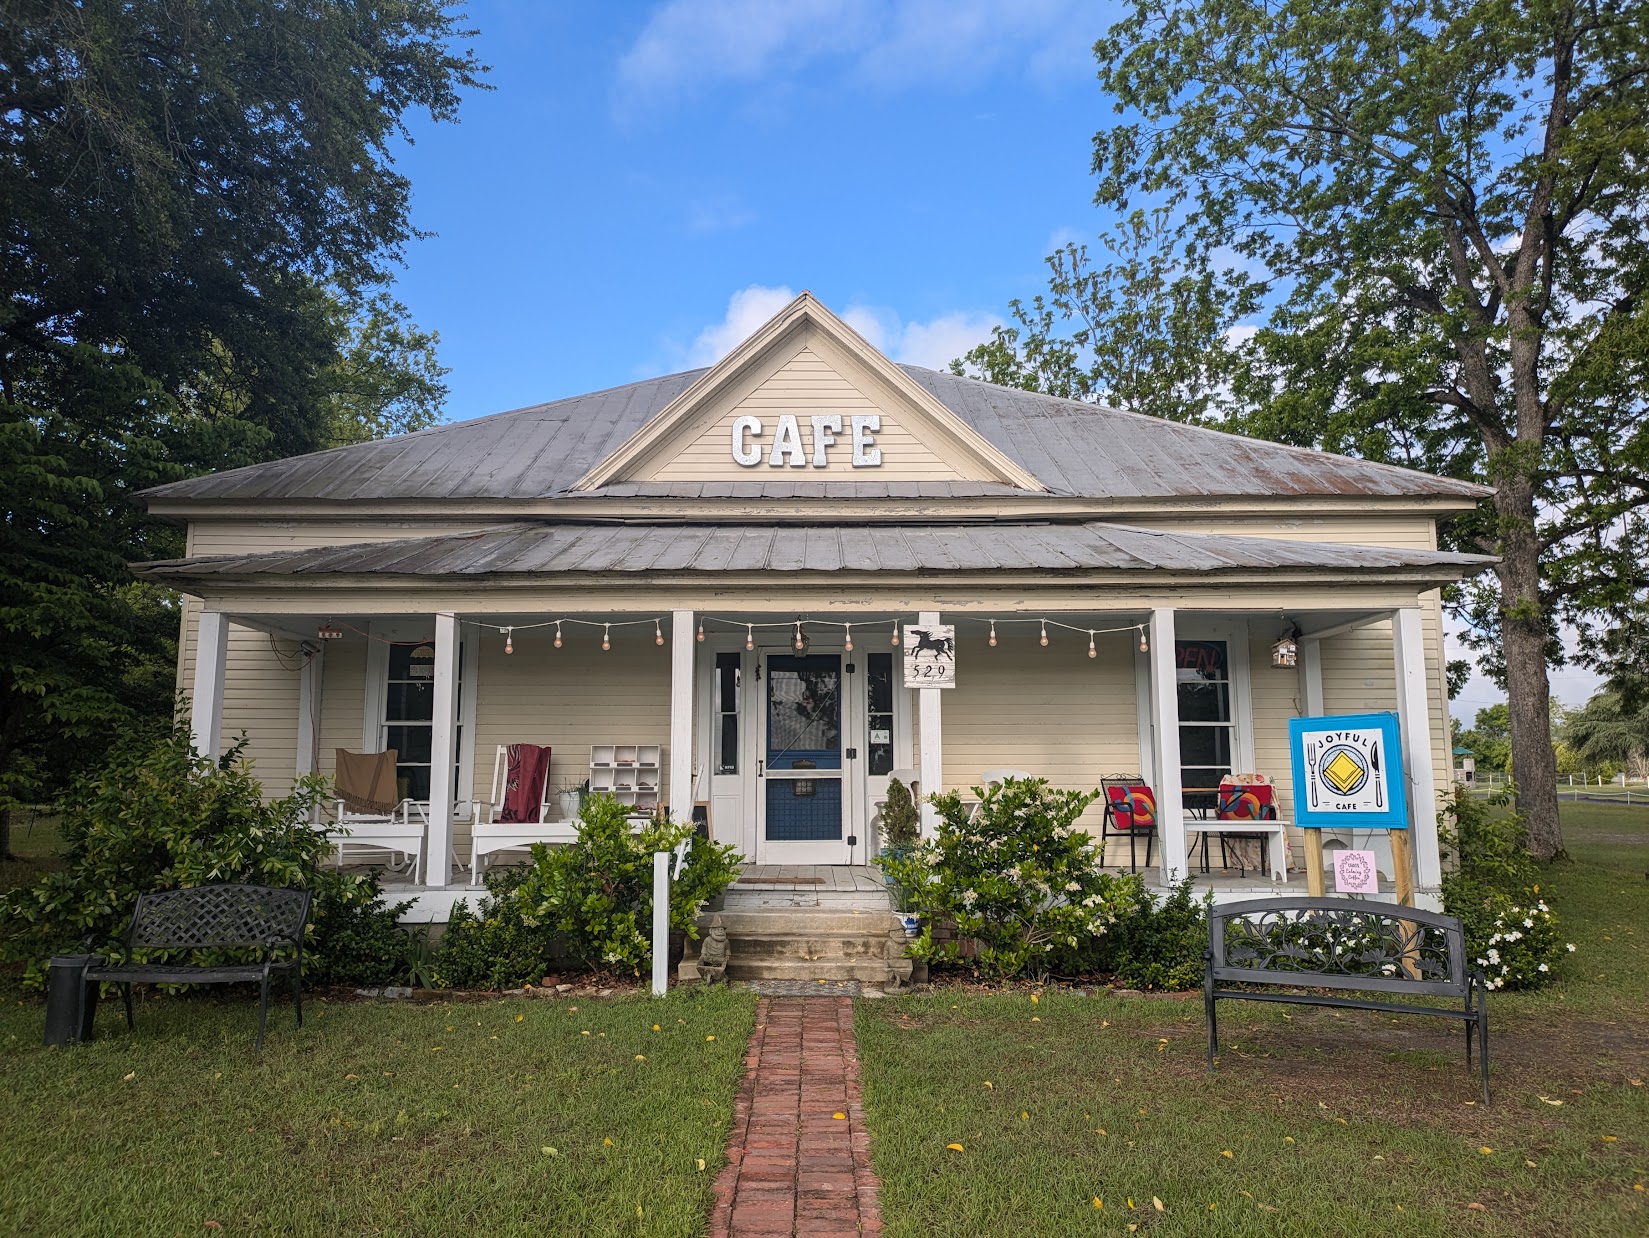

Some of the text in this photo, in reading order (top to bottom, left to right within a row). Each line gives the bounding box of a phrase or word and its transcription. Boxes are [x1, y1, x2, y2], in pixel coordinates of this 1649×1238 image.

[731, 414, 882, 468] CAFE
[1176, 646, 1217, 672] PEN
[912, 664, 945, 679] 529
[1318, 732, 1367, 748] JOYFUL
